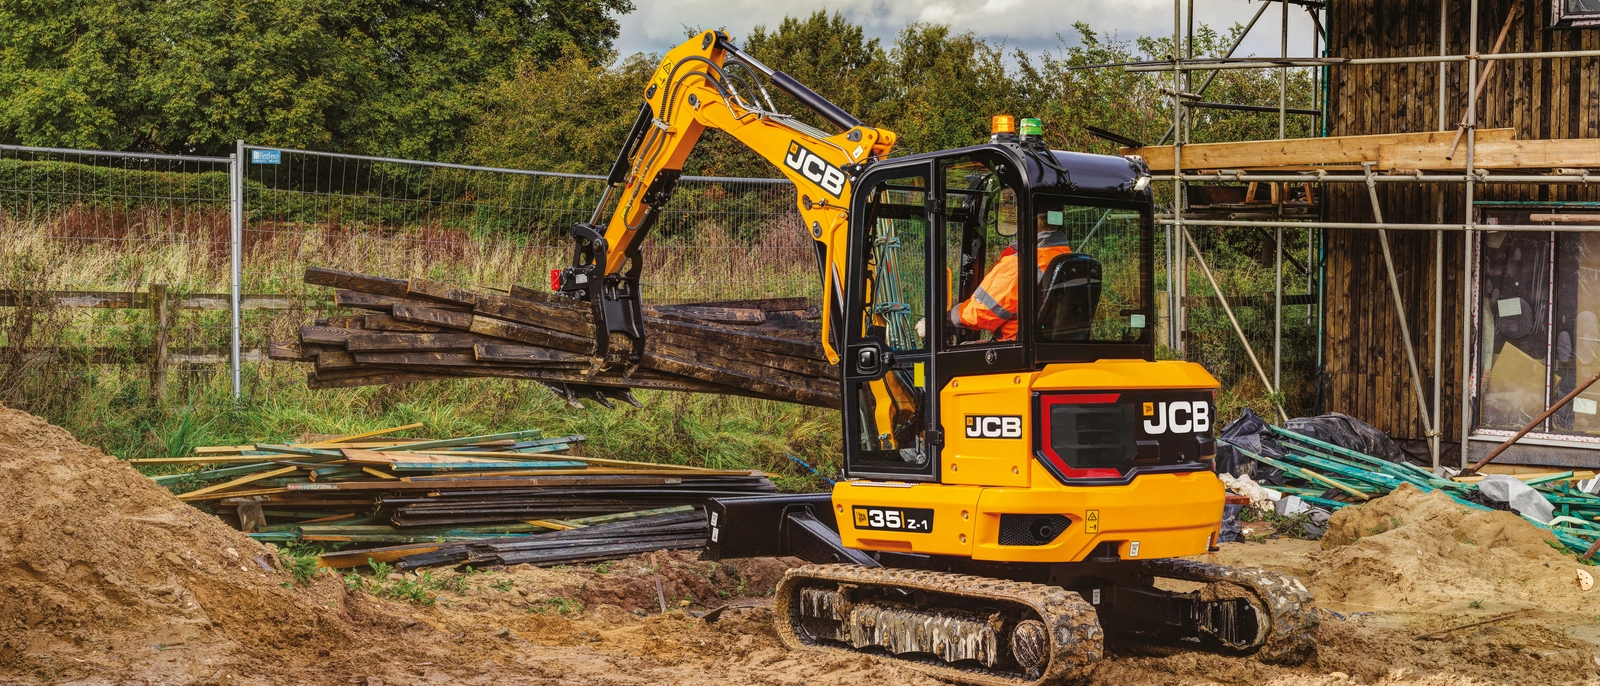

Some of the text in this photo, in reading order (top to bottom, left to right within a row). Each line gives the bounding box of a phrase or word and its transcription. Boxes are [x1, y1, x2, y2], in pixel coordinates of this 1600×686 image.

[787, 148, 845, 195] JCB
[966, 416, 1022, 438] JCB
[1143, 401, 1210, 434] JCB
[869, 509, 901, 528] 35
[907, 519, 928, 530] Z-1
